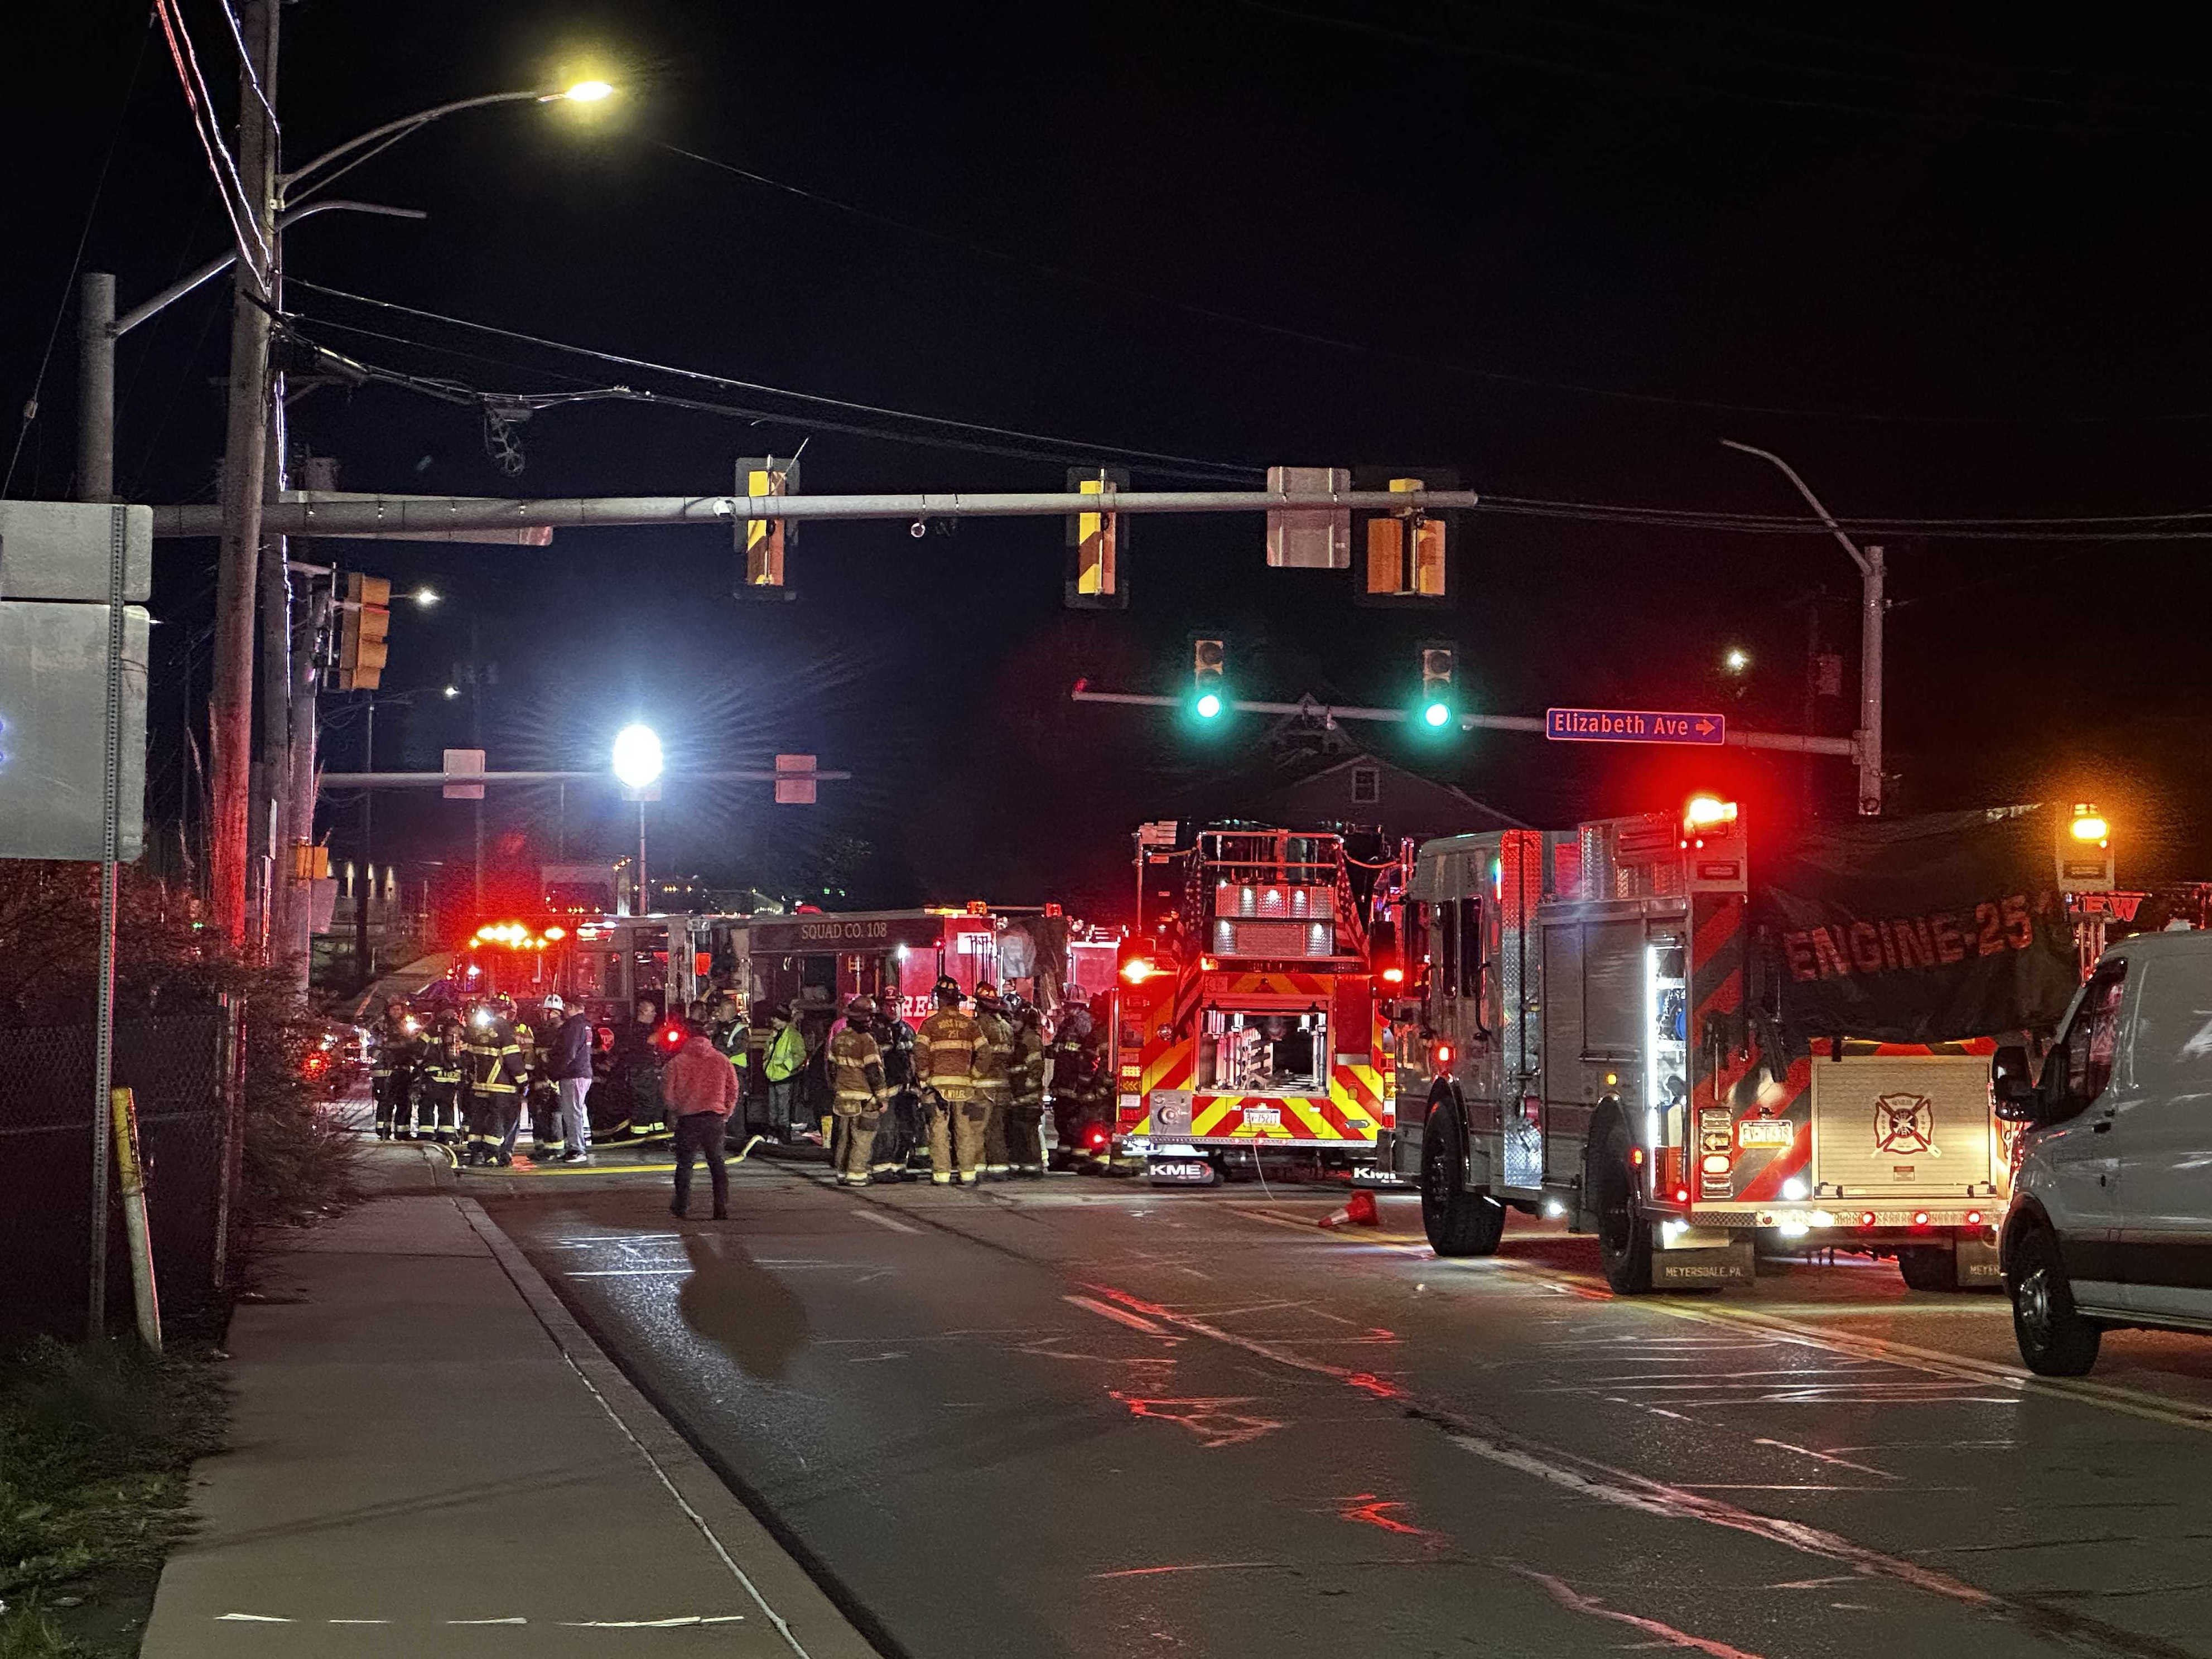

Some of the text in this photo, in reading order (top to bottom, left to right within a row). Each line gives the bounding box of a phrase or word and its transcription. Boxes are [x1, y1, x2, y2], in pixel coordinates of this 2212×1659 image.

[1554, 712, 1688, 735] Elizabeth Ave
[801, 922, 888, 940] SQUAD CO. 108
[1784, 894, 2053, 982] ENGINE-25
[902, 995, 929, 1017] RE
[1150, 1164, 1201, 1176] KME
[1970, 1264, 2001, 1276] MEYER
